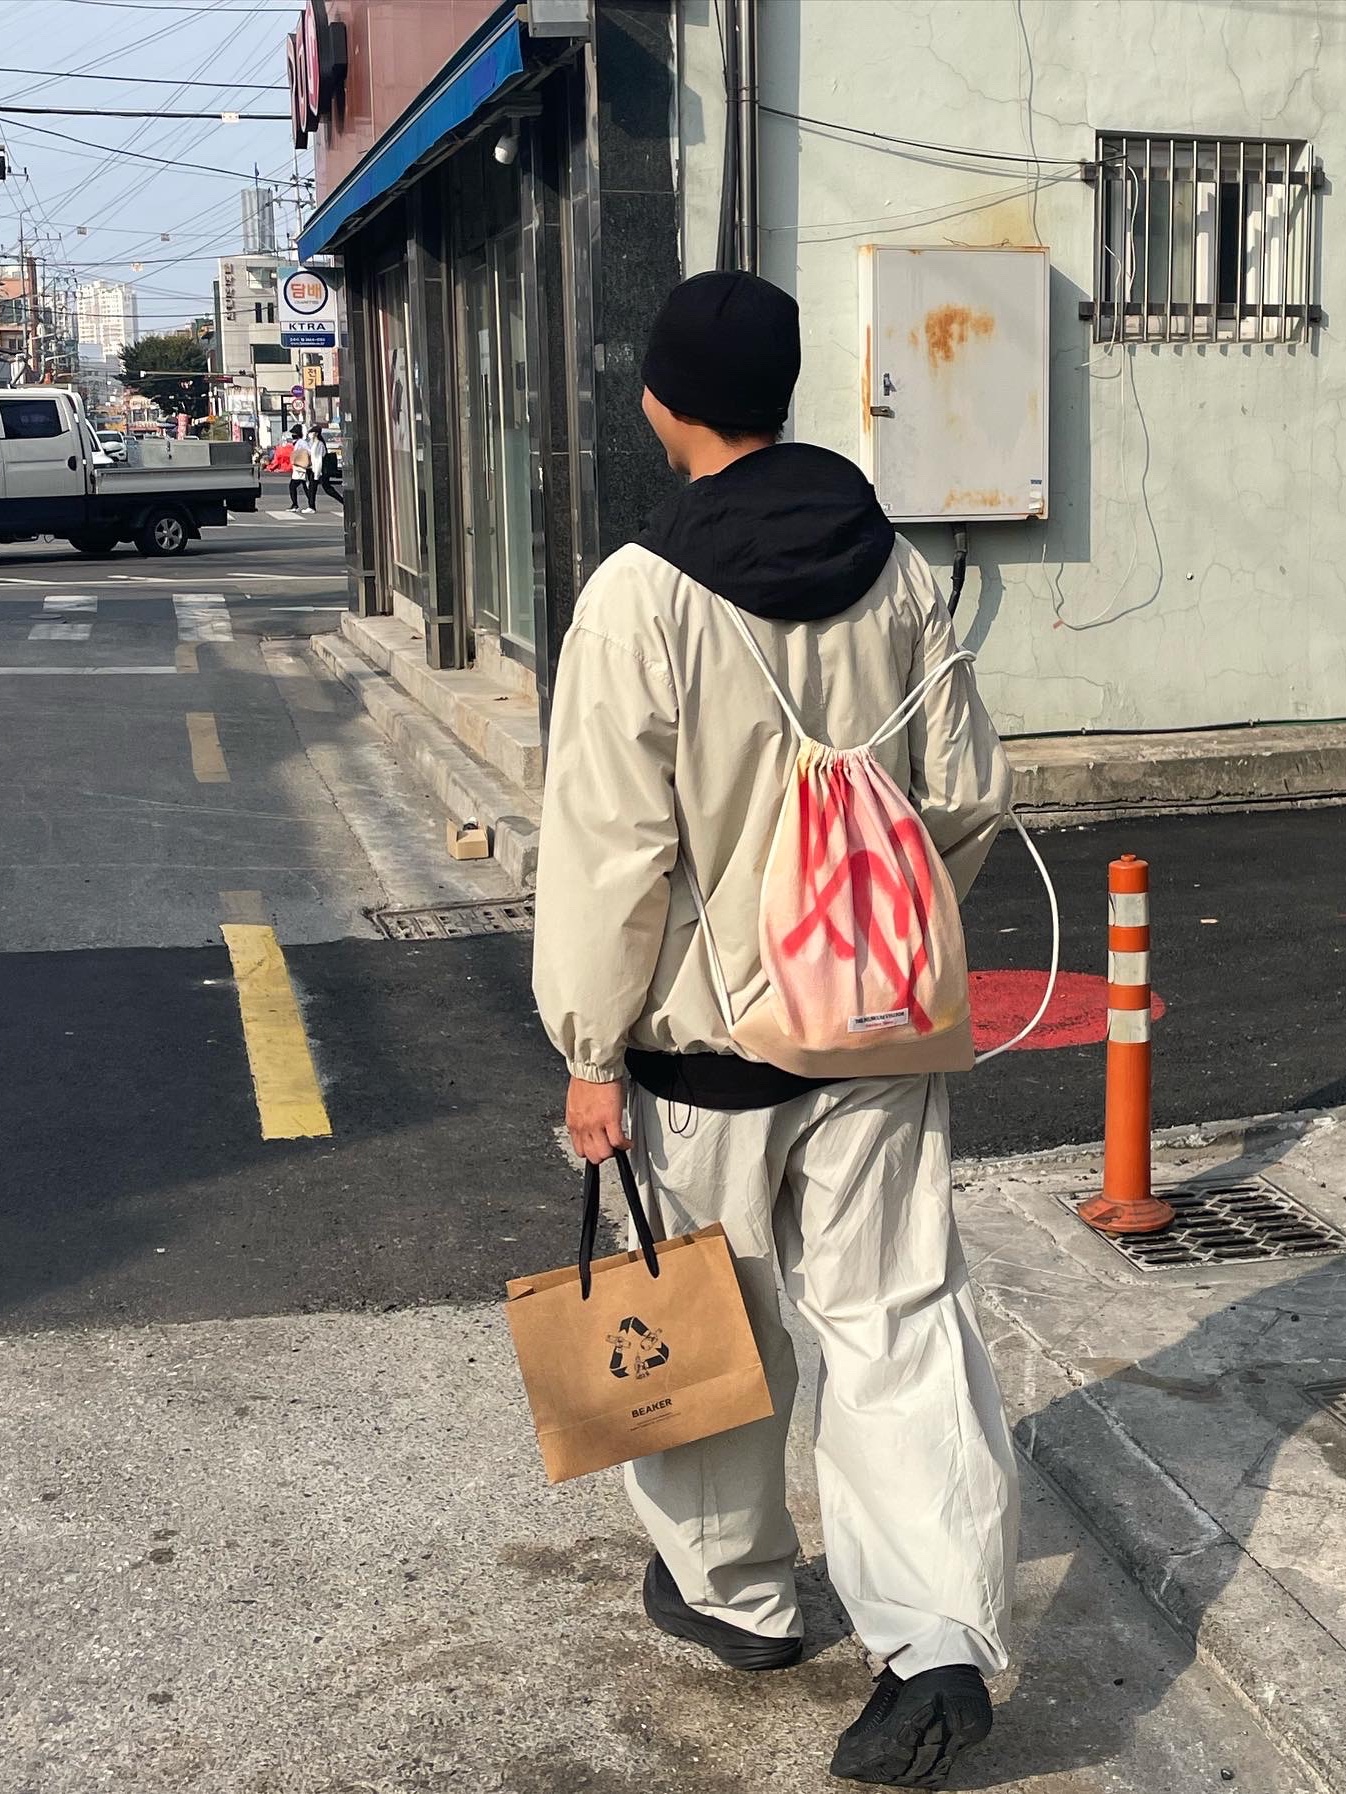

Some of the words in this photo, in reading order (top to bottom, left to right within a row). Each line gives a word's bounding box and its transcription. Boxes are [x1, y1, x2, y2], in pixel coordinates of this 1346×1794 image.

[291, 283, 322, 299] 담배
[289, 322, 326, 331] KTRA
[631, 1398, 673, 1418] BEAKER
